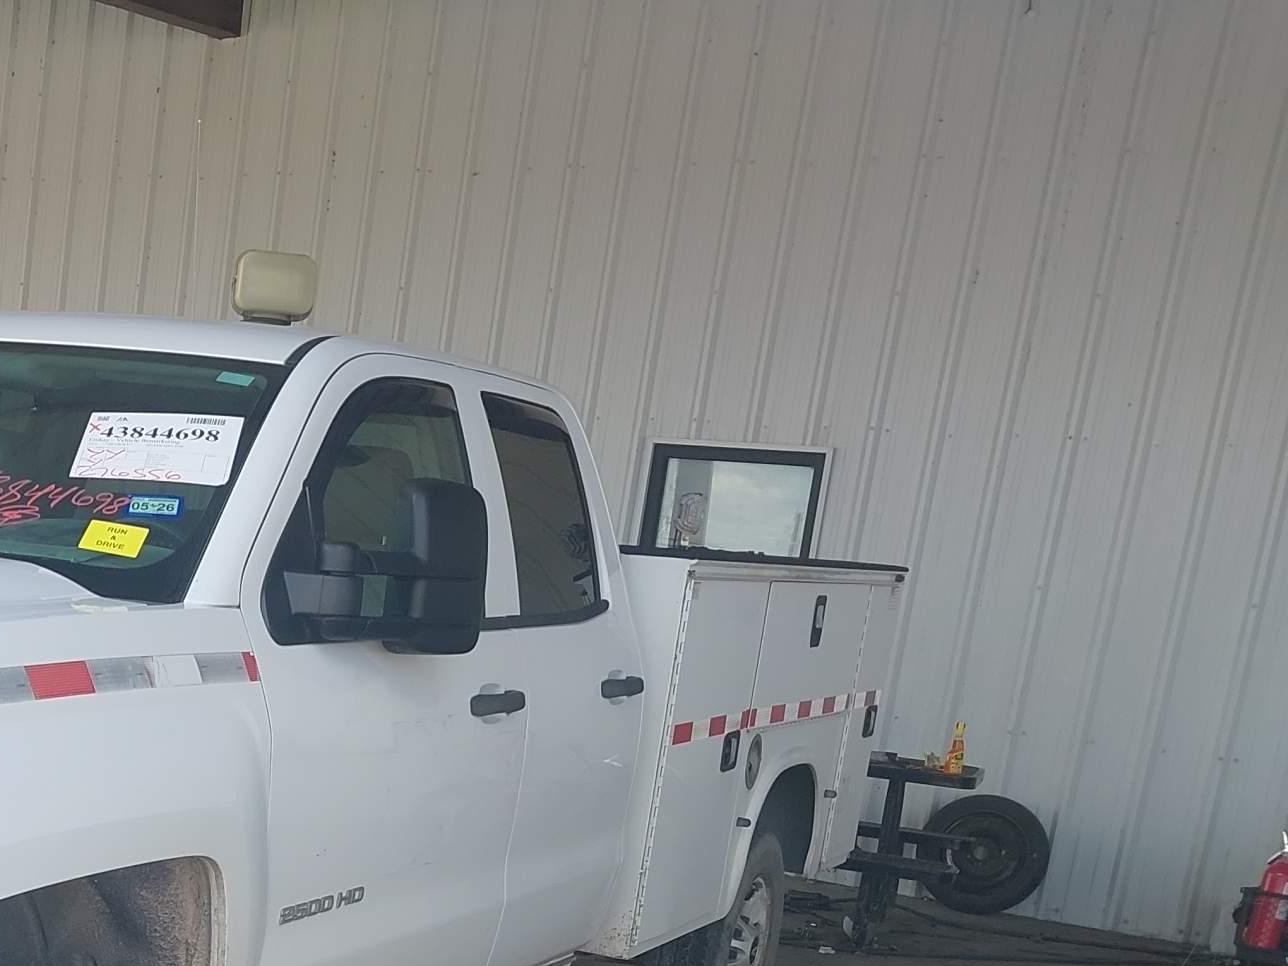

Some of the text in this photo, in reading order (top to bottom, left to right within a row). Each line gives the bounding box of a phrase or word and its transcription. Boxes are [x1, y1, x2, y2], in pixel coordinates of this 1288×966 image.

[100, 426, 220, 442] 43844698
[106, 526, 129, 535] RUN
[95, 539, 126, 550] DRIVE
[278, 886, 365, 926] 2500 HD
